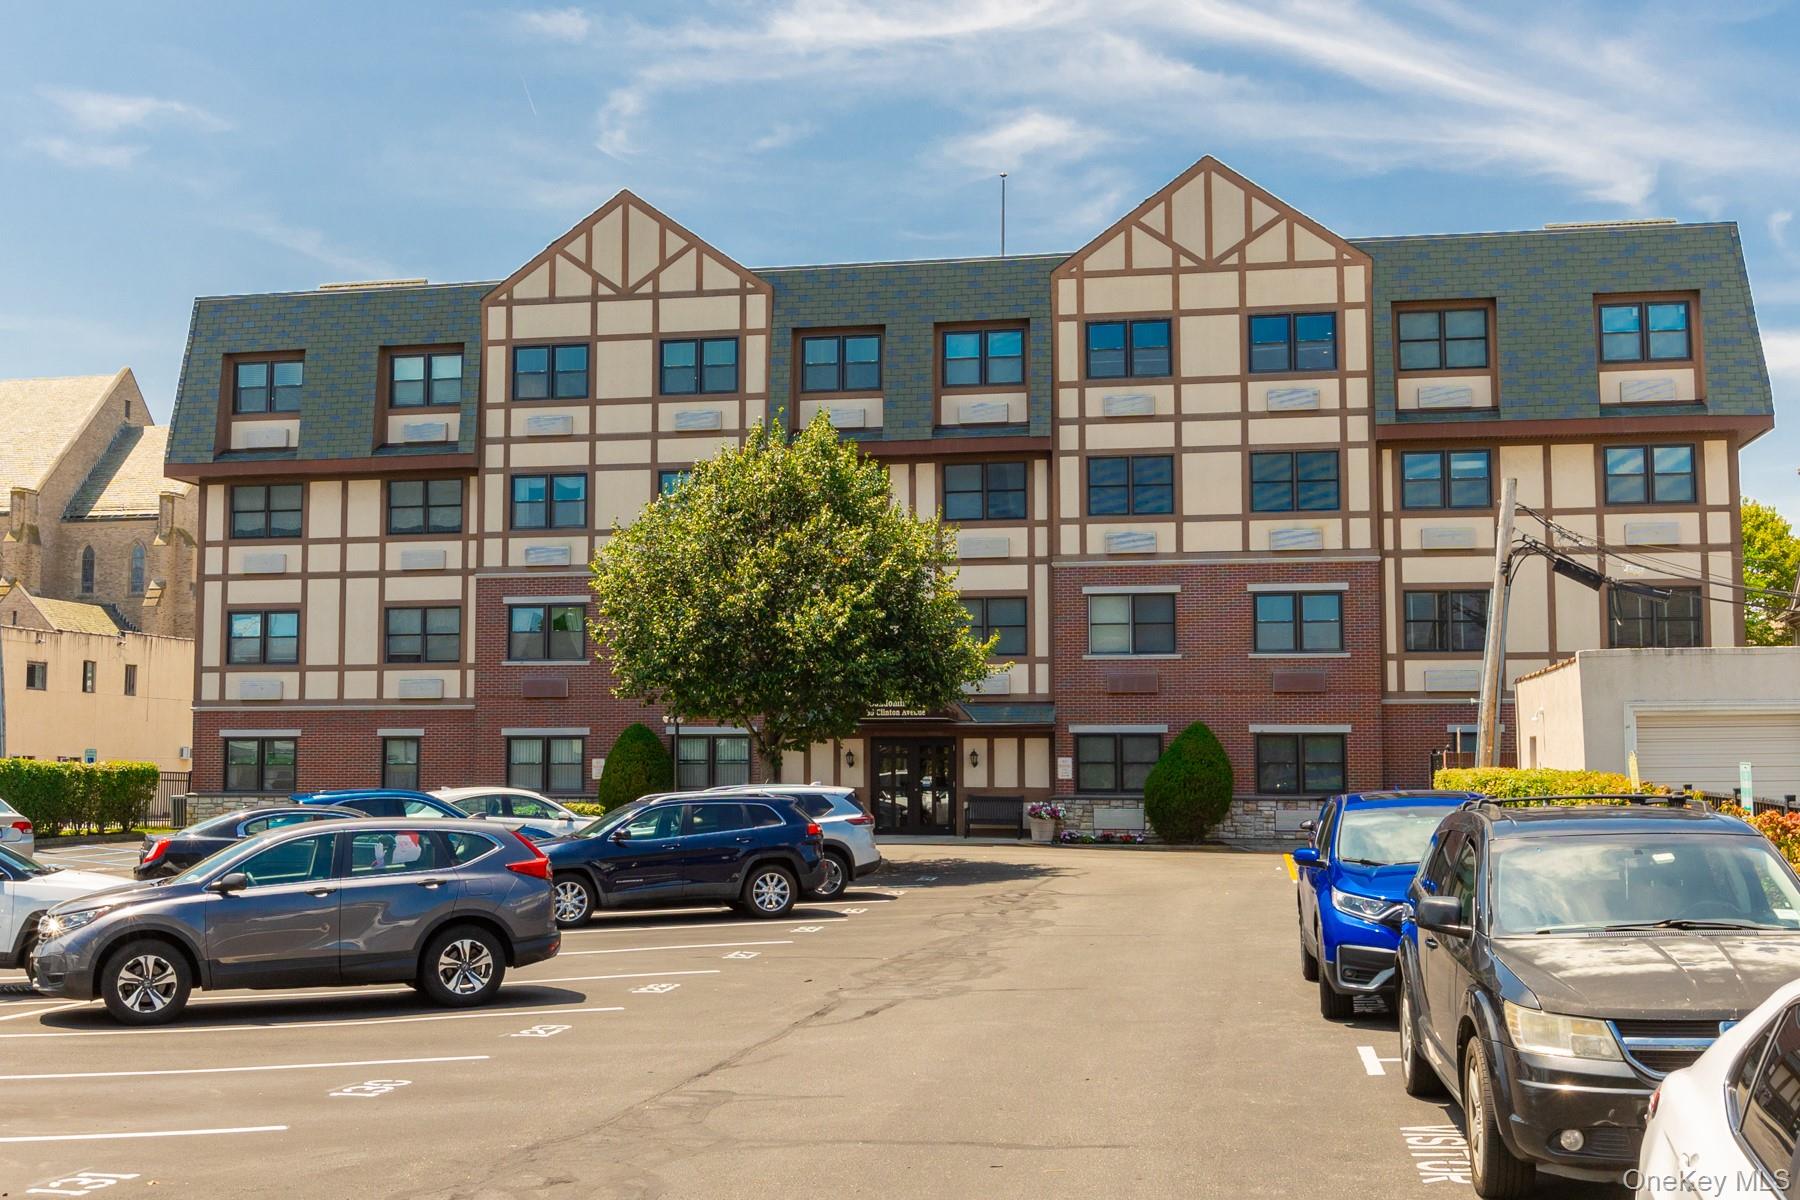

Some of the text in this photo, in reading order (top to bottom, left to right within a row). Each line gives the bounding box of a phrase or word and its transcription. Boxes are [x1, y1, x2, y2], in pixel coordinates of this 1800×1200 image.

[876, 708, 900, 716] Clinton
[902, 709, 926, 717] Avenue
[510, 1024, 573, 1038] 129
[329, 1079, 413, 1098] 130
[1400, 1125, 1473, 1184] VISITOR
[25, 1172, 141, 1197] 131
